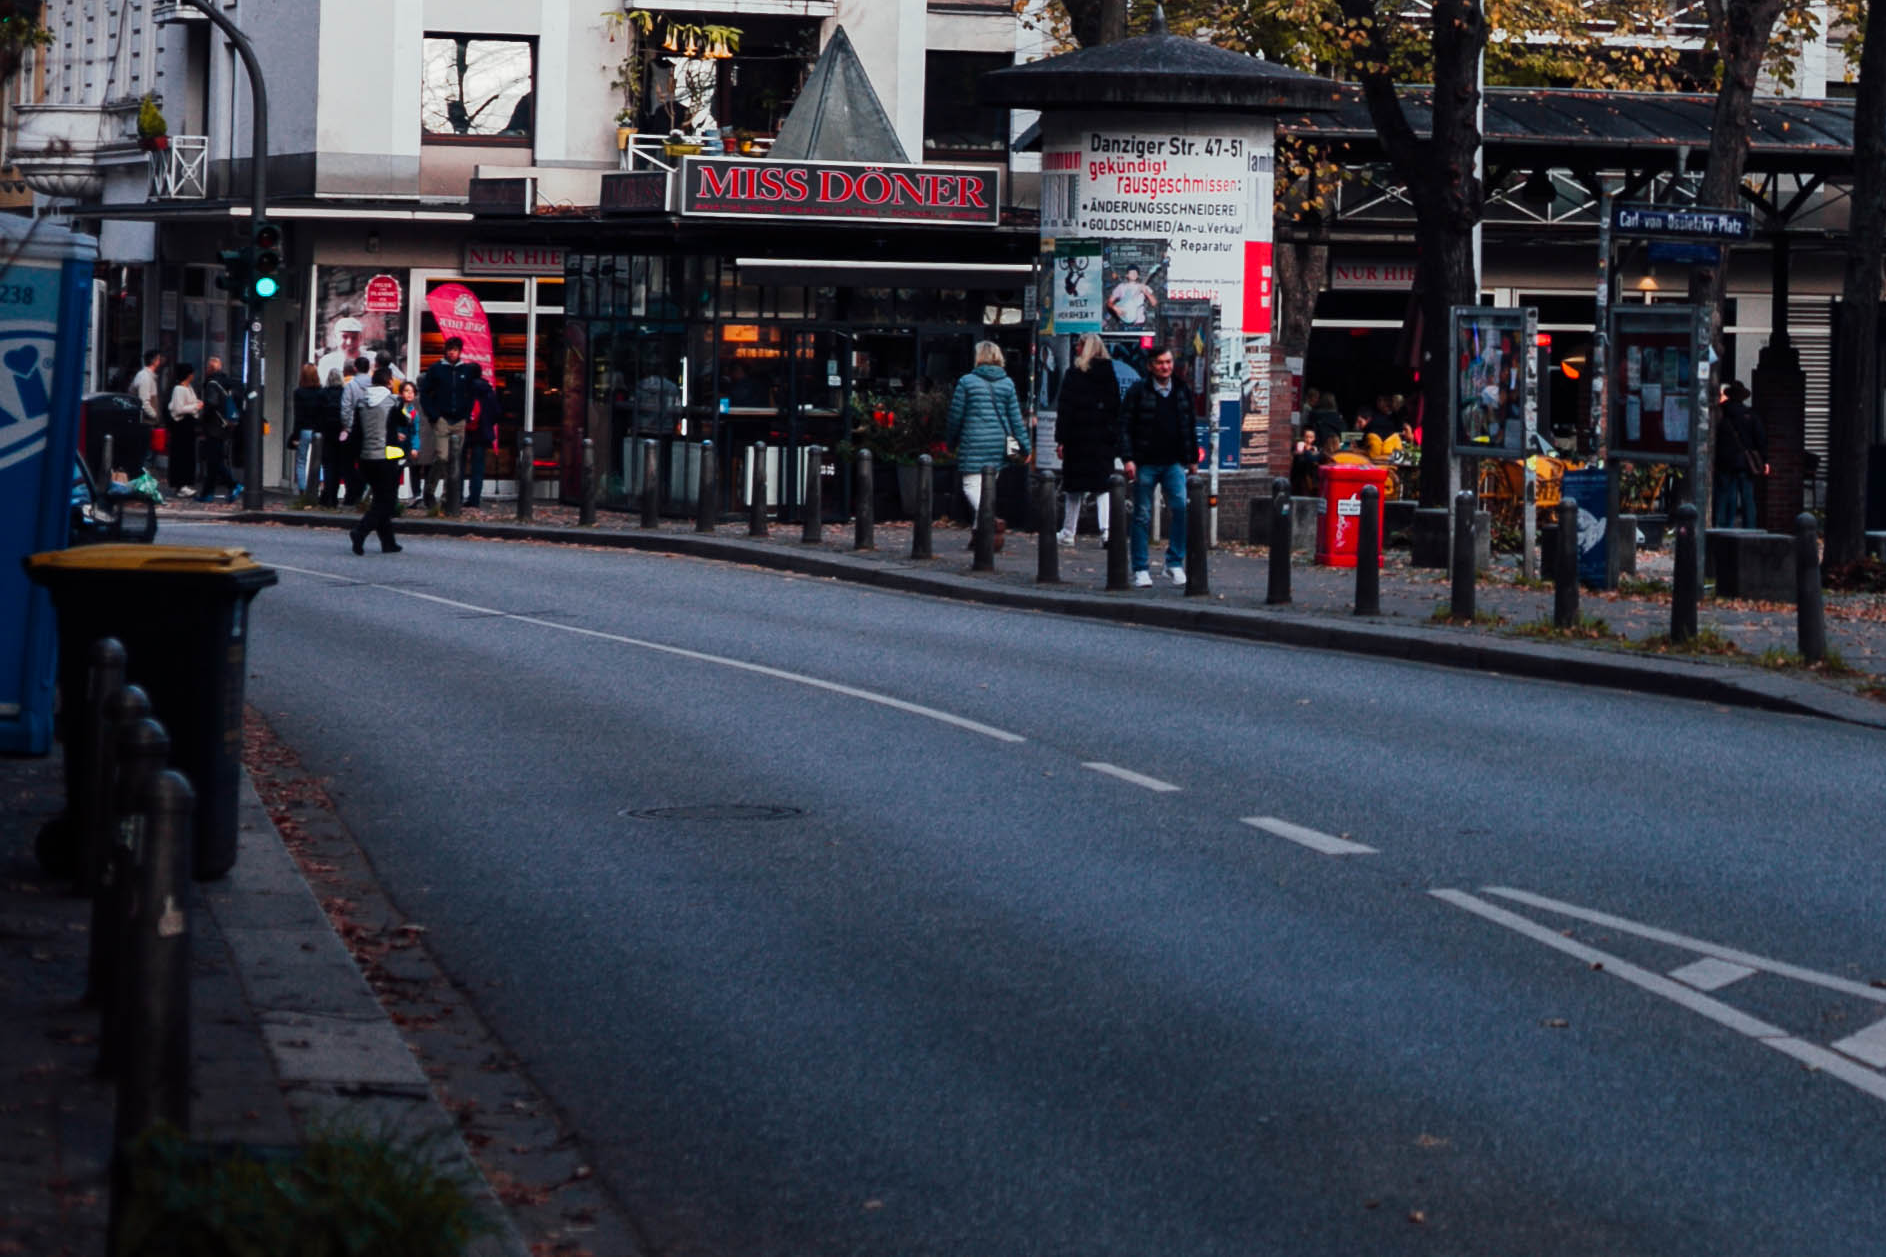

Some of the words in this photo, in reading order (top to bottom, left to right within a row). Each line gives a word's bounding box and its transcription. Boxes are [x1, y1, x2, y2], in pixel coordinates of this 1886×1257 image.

[1091, 133, 1166, 158] Danziger
[1169, 137, 1199, 156] Str.
[1205, 139, 1243, 157] 47-51
[1089, 156, 1167, 181] gekündigt
[696, 165, 809, 202] MISS
[816, 164, 988, 208] DÖNER
[1117, 173, 1242, 200] rausgeschmissen:
[1090, 198, 1237, 216] ÄNDERUNGSSCHNEIDEREI
[469, 249, 516, 264] NUR
[1181, 240, 1232, 253] Reparatur
[1336, 266, 1377, 280] NUR
